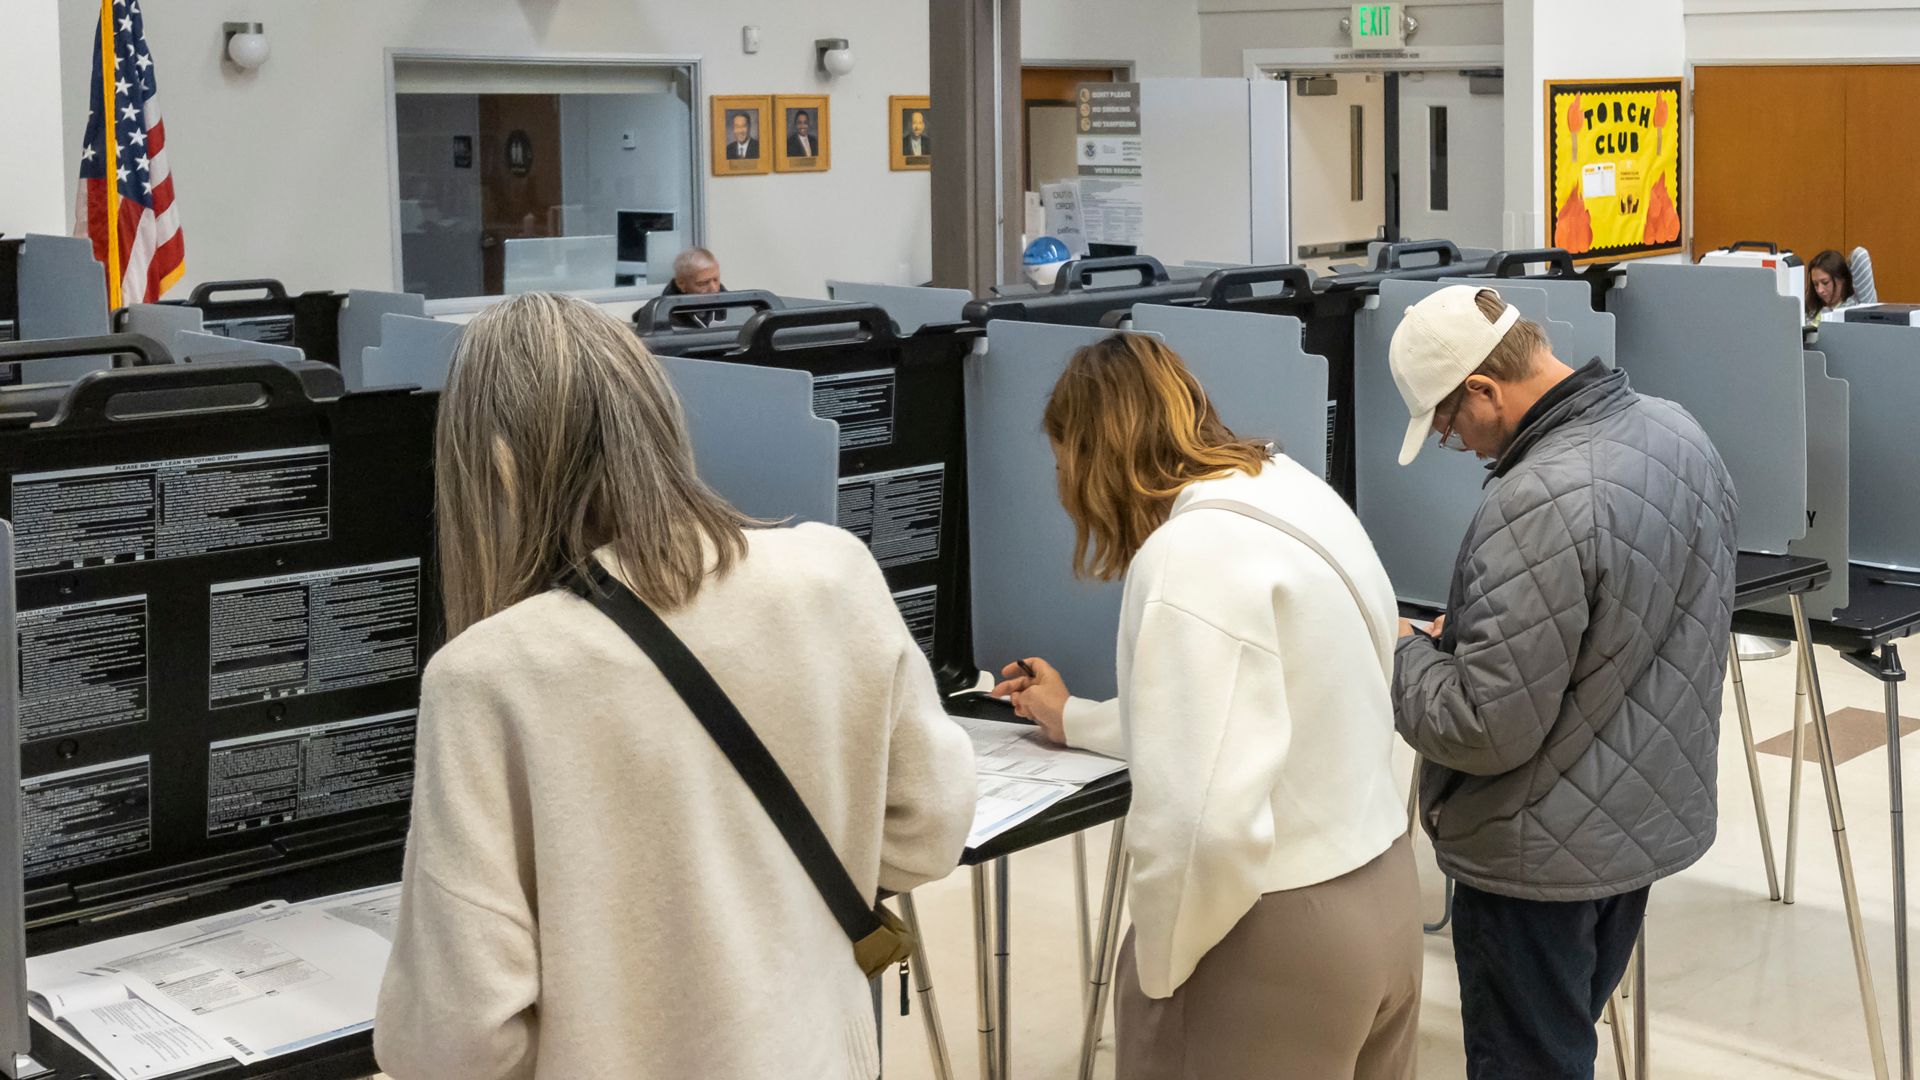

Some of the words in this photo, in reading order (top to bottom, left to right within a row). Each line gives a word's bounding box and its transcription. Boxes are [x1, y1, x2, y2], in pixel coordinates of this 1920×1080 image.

[1359, 6, 1391, 37] EXIT
[1583, 101, 1652, 131] TORCH
[1595, 131, 1640, 155] CLUB
